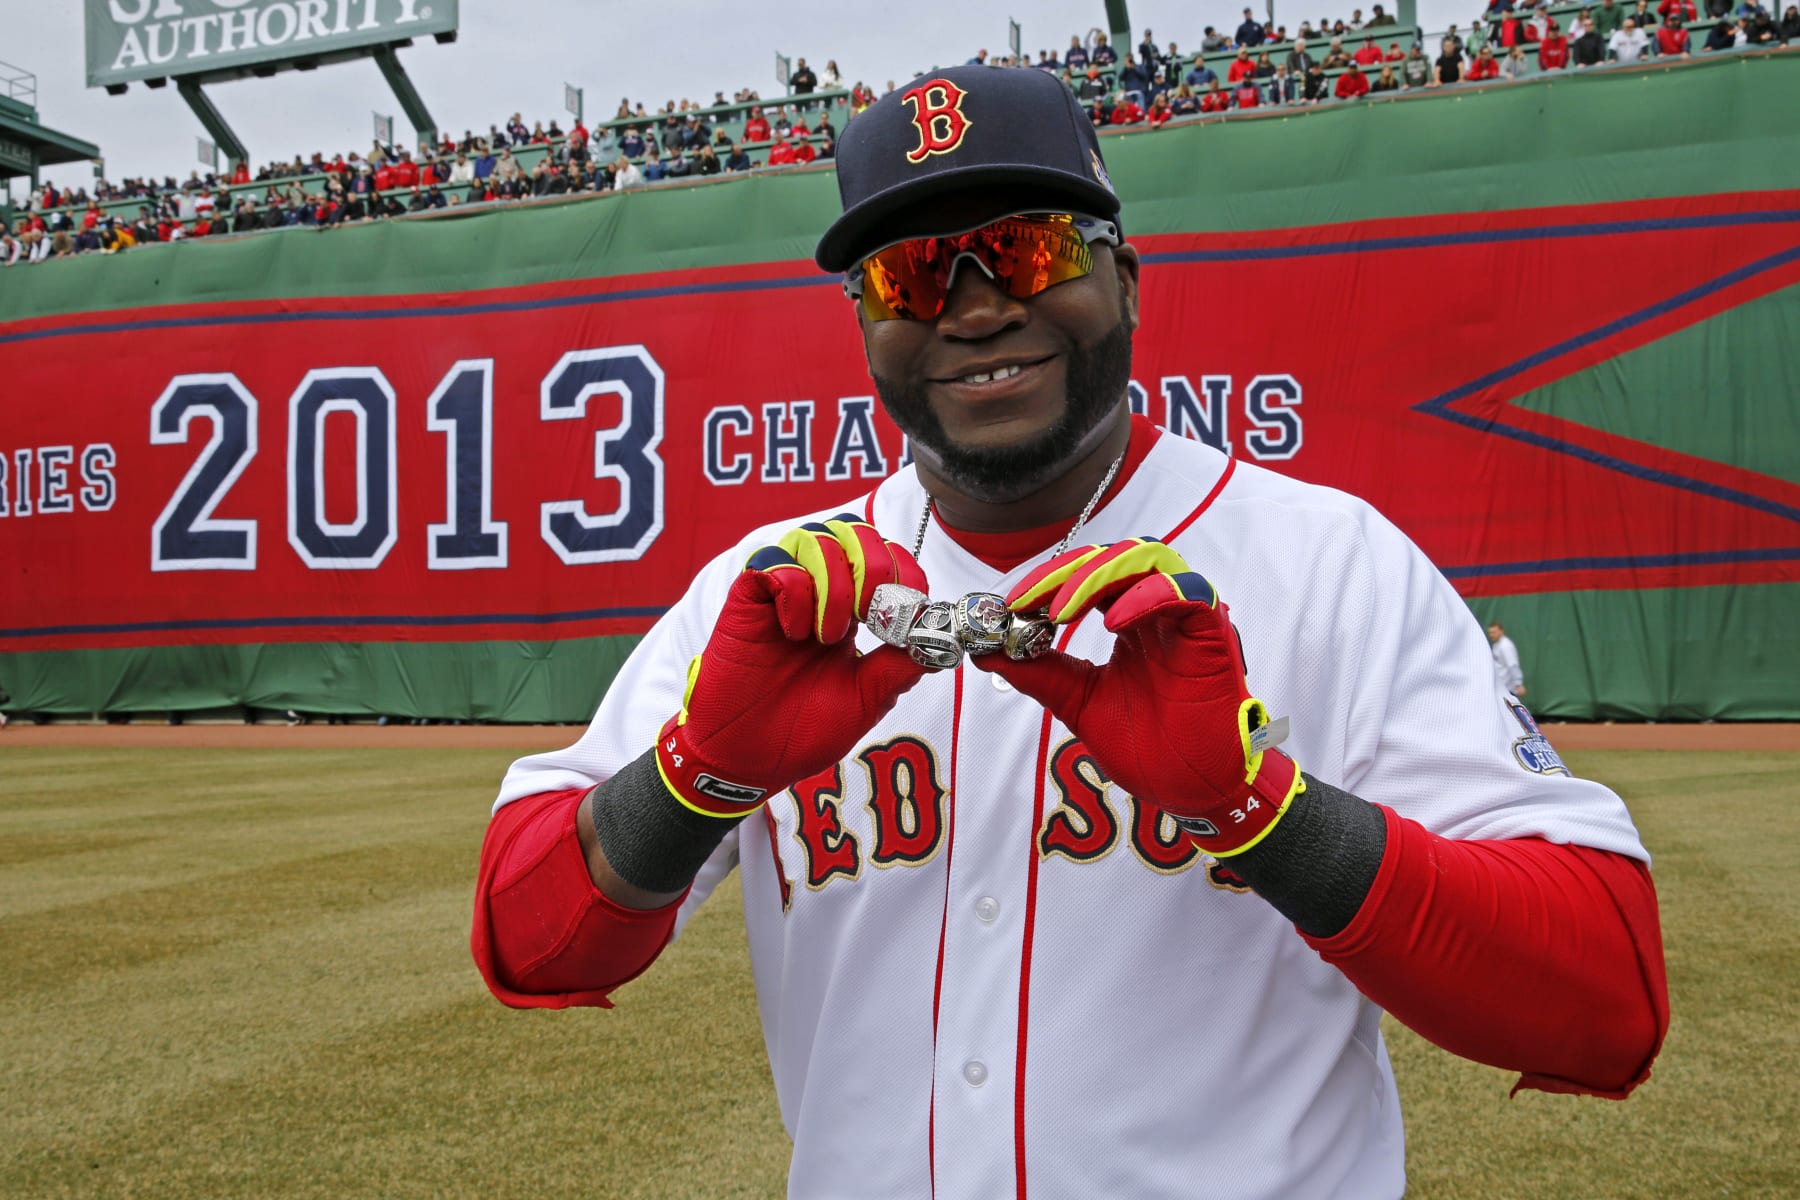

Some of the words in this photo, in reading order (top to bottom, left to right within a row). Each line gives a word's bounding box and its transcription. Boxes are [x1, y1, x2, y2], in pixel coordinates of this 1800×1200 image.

[111, 0, 419, 70] AUTHORITY
[902, 78, 973, 164] B
[0, 443, 116, 518] IES
[150, 343, 664, 571] 2013
[703, 373, 1303, 487] CHANS
[666, 736, 684, 768] 34
[766, 732, 951, 915] ED
[1229, 795, 1261, 824] 34
